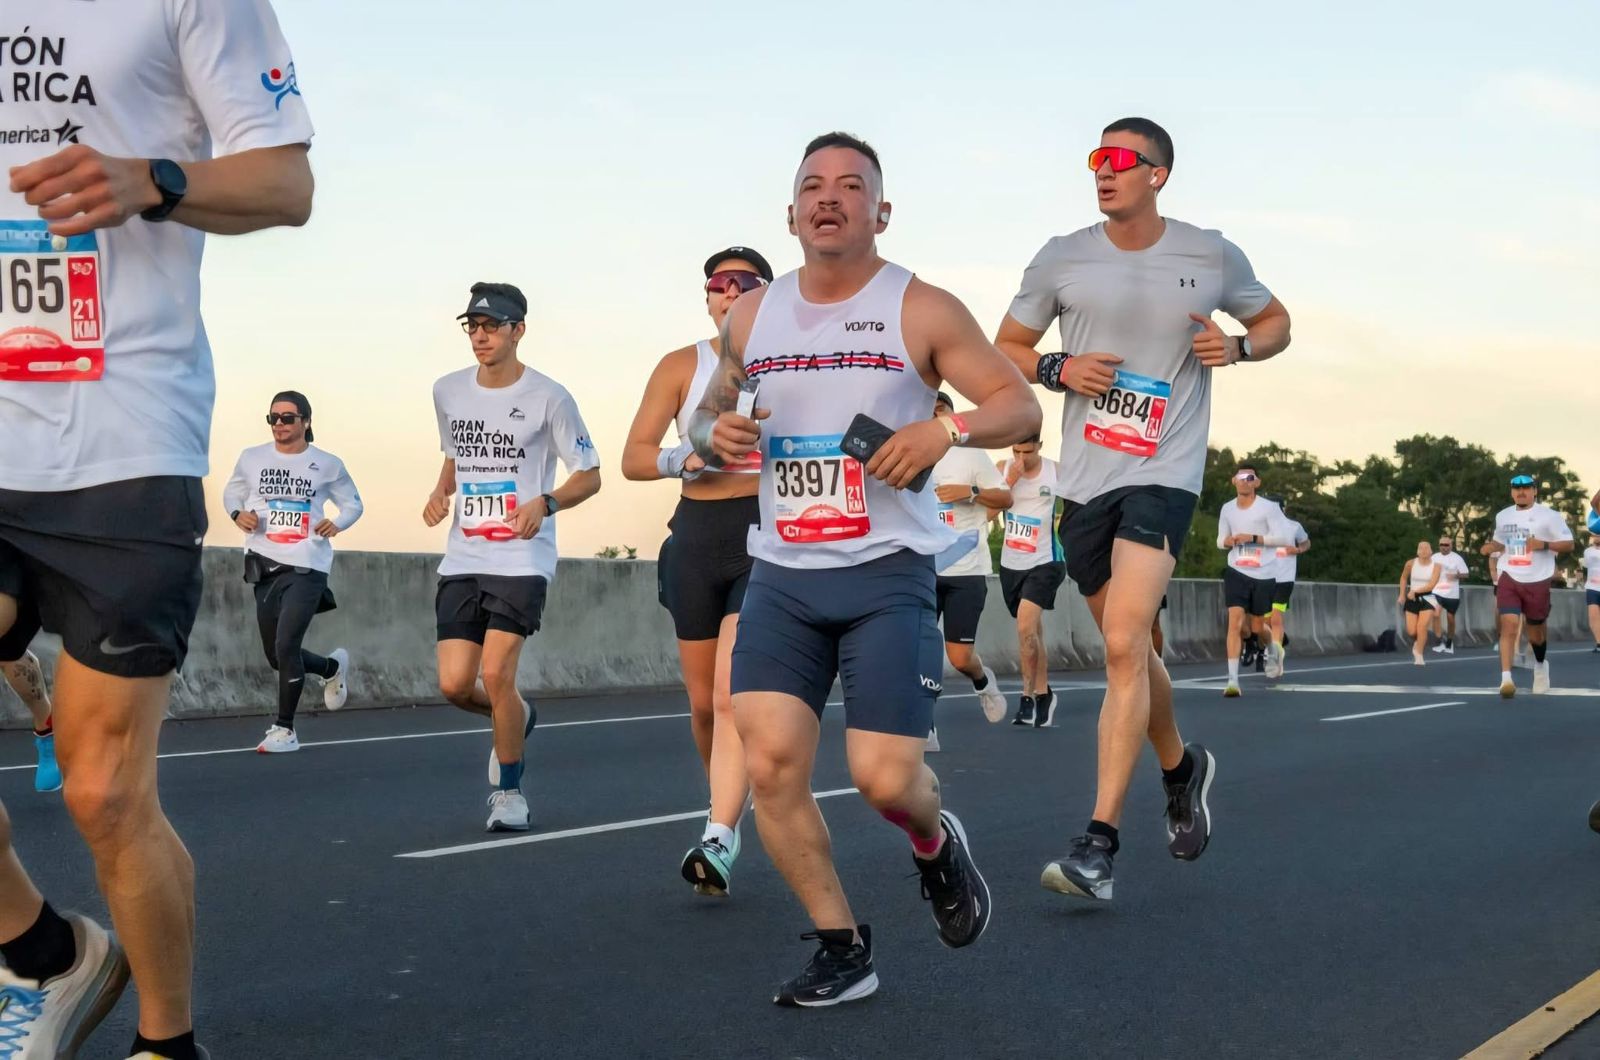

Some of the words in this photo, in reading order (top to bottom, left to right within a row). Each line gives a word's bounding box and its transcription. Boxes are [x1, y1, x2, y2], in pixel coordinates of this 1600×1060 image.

[13, 71, 97, 106] RICA
[73, 298, 94, 320] 21
[73, 320, 97, 339] KM
[451, 420, 484, 432] GRAN
[454, 445, 489, 458] OSTA
[493, 447, 526, 459] RICA
[261, 468, 290, 478] GRAN
[775, 459, 841, 498] 3397
[260, 476, 312, 488] MARATÓN
[259, 485, 292, 495] COSTA
[847, 486, 860, 500] 21
[464, 495, 504, 517] 5171
[848, 499, 864, 512] KM
[269, 510, 302, 527] 2332
